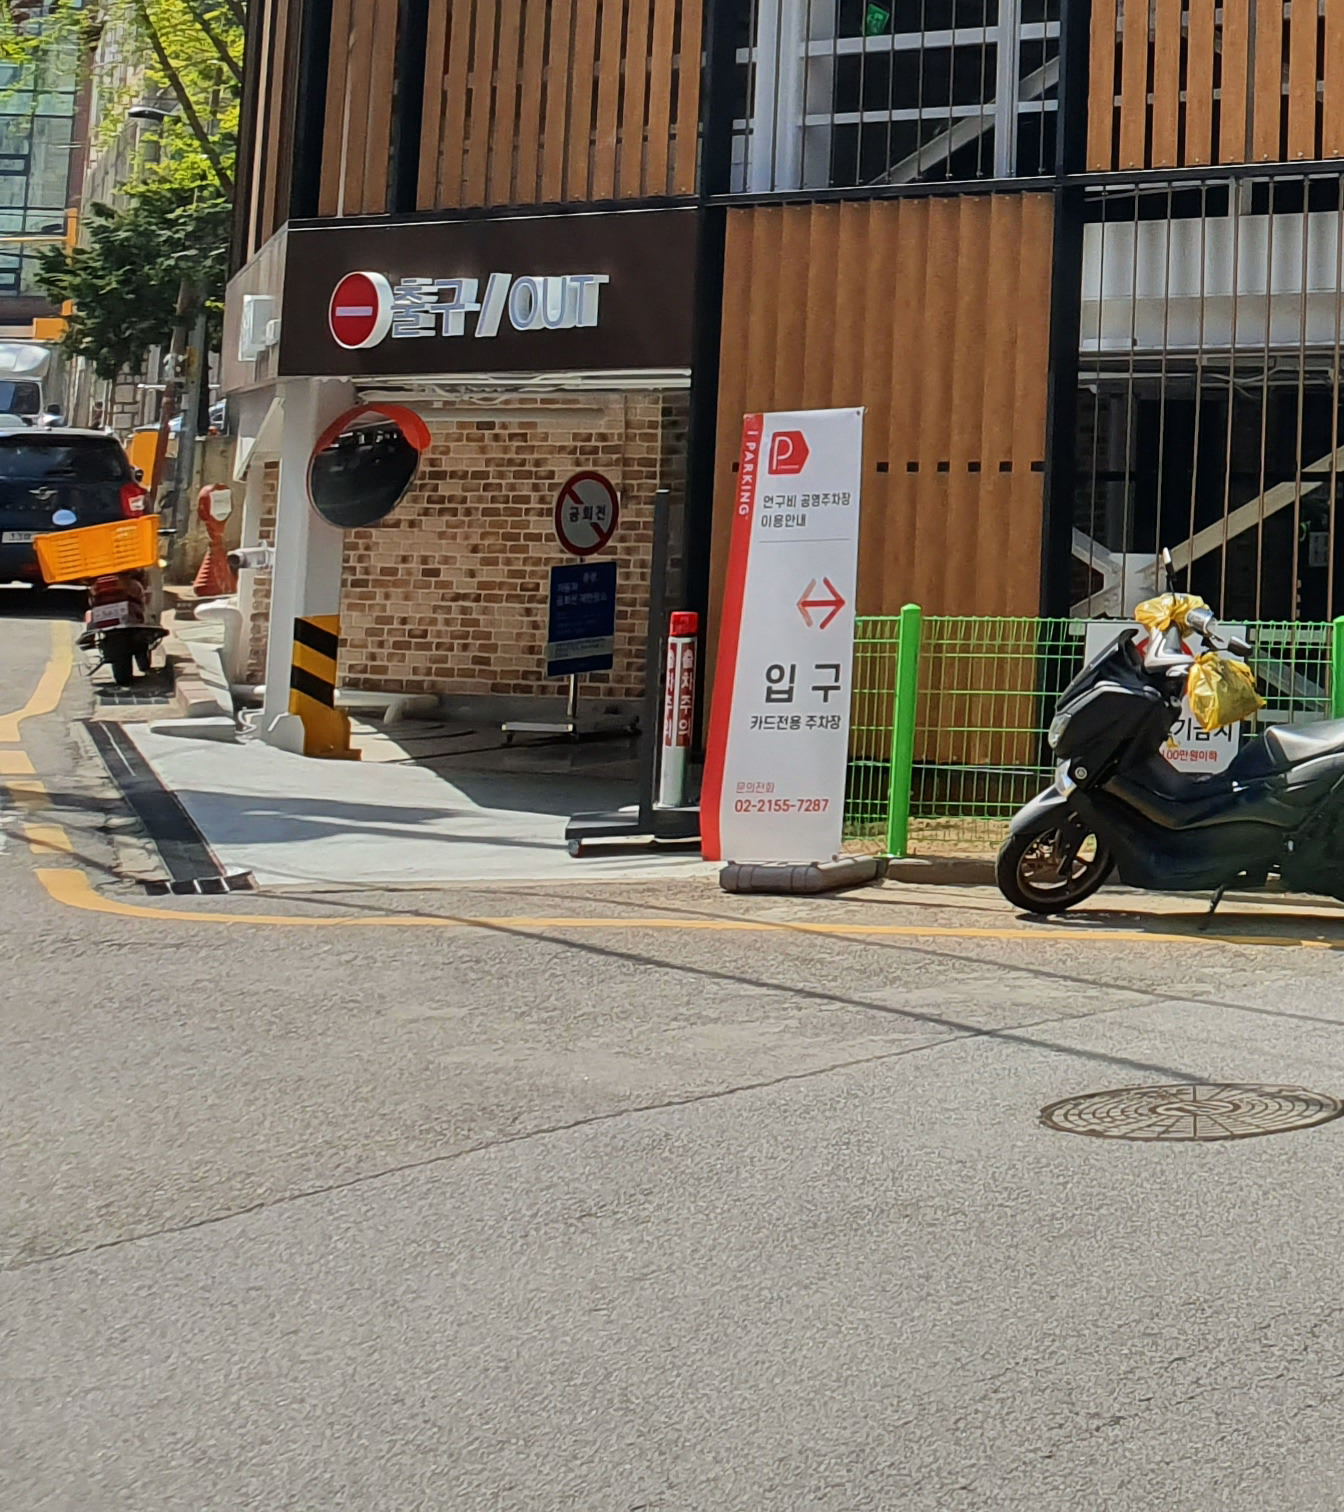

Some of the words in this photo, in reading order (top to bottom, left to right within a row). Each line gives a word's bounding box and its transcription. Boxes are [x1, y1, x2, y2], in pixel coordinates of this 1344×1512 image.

[738, 441, 757, 516] PARKING
[763, 494, 797, 509] 언구비
[800, 492, 851, 508] 공영주차장
[569, 504, 607, 523] 공회전
[761, 514, 806, 528] 이용안내
[750, 715, 802, 730] 카드전용
[805, 715, 841, 730] 주차장
[736, 782, 775, 794] 문의전화
[735, 799, 830, 813] 02-2155-7287
